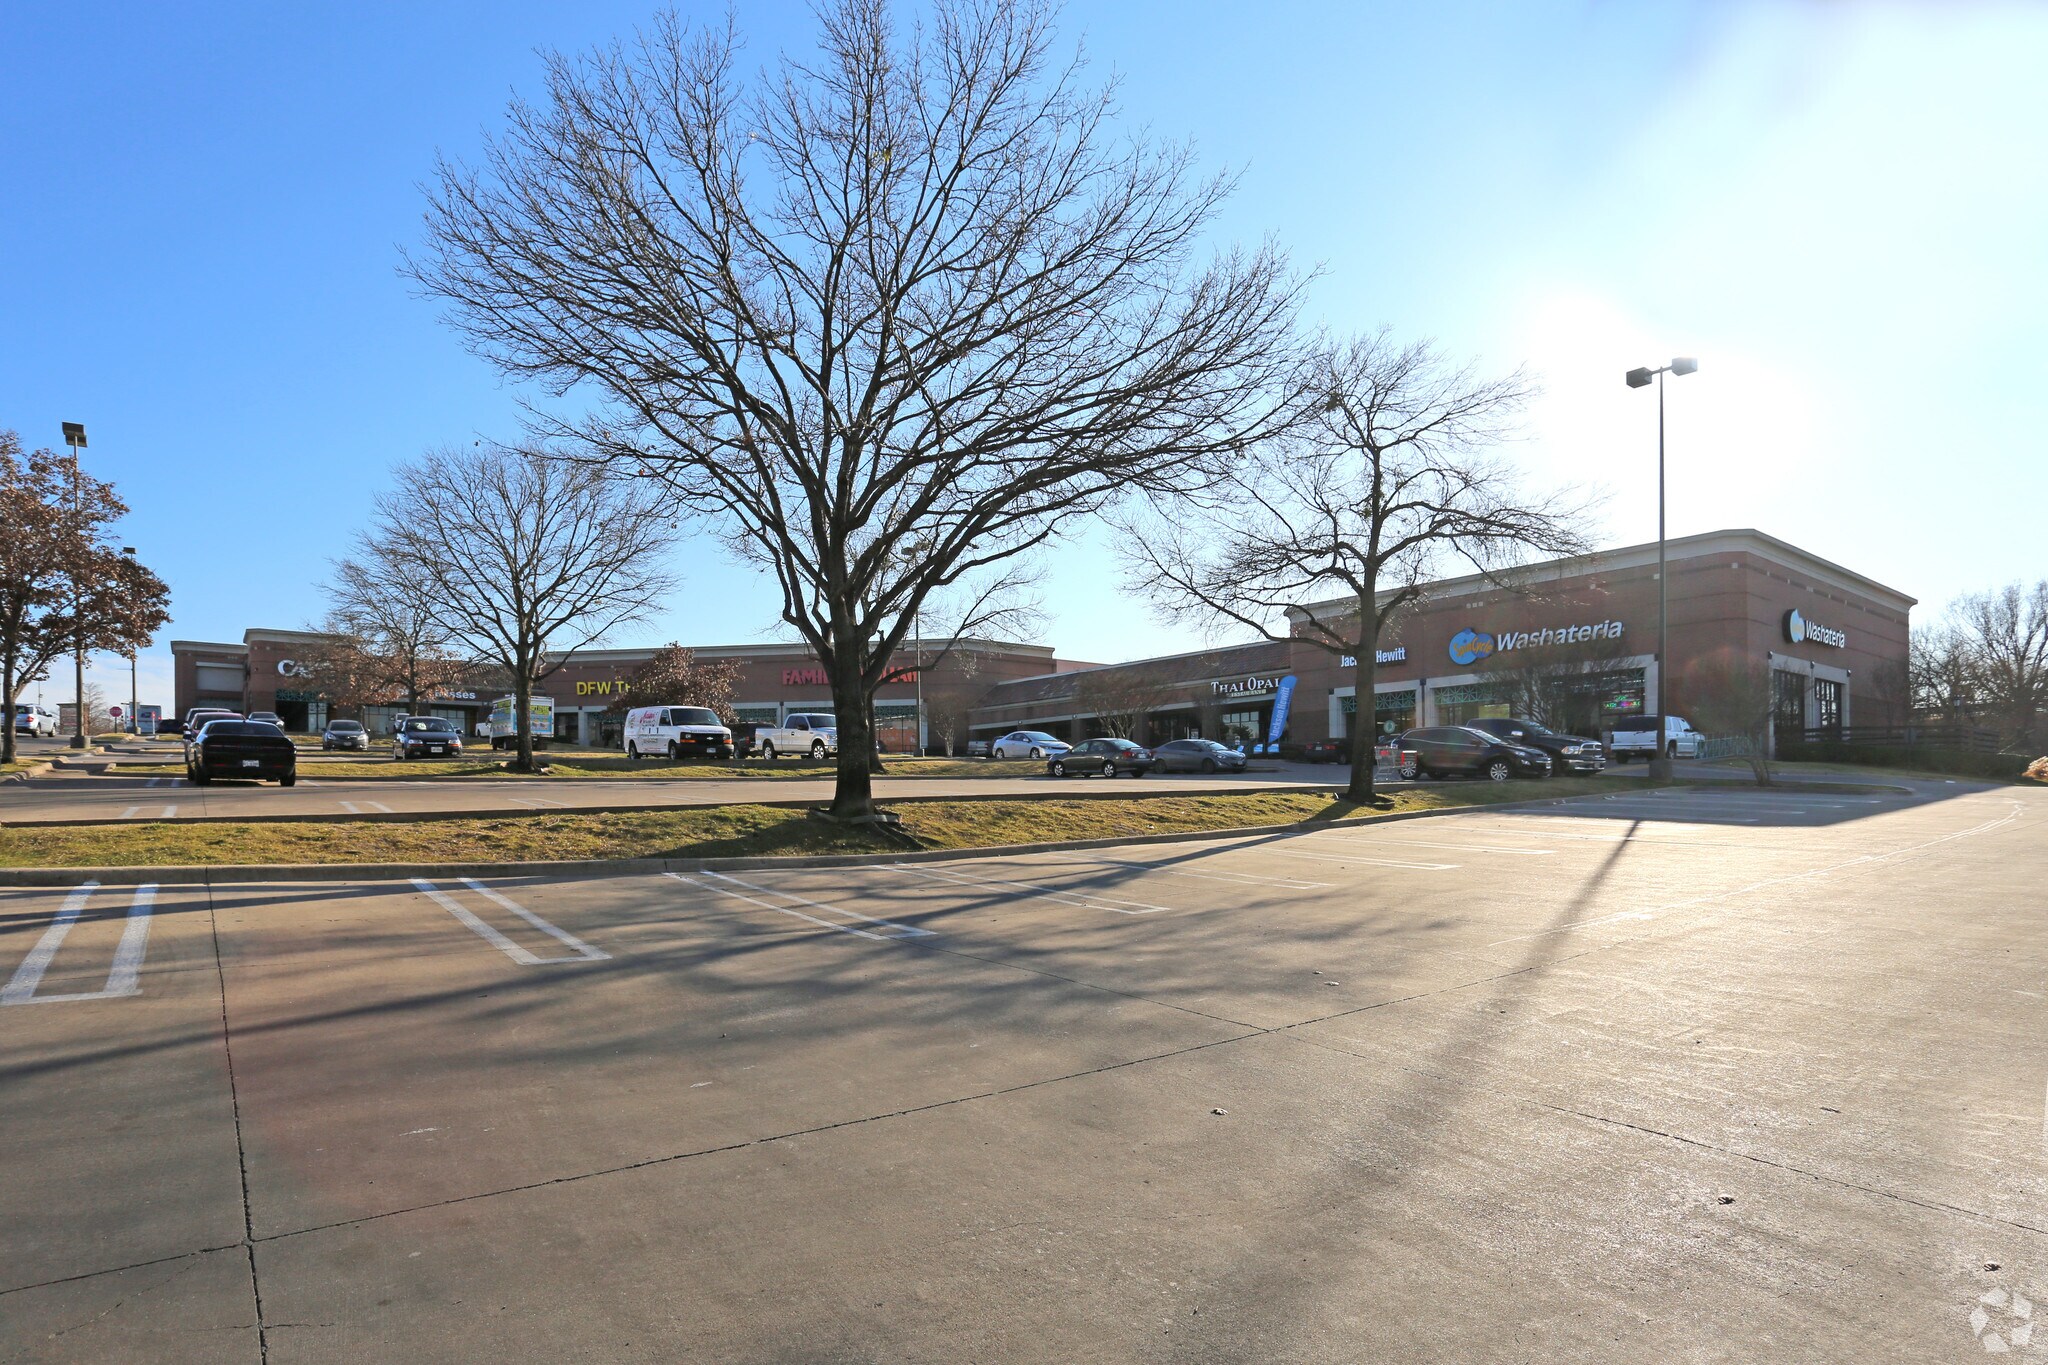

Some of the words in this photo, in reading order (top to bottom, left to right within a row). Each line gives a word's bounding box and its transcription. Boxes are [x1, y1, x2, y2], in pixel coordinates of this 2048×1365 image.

[1497, 619, 1623, 652] Washateria
[1806, 619, 1845, 649] Washateria
[1375, 646, 1406, 664] Hewitt
[576, 680, 612, 696] DFW
